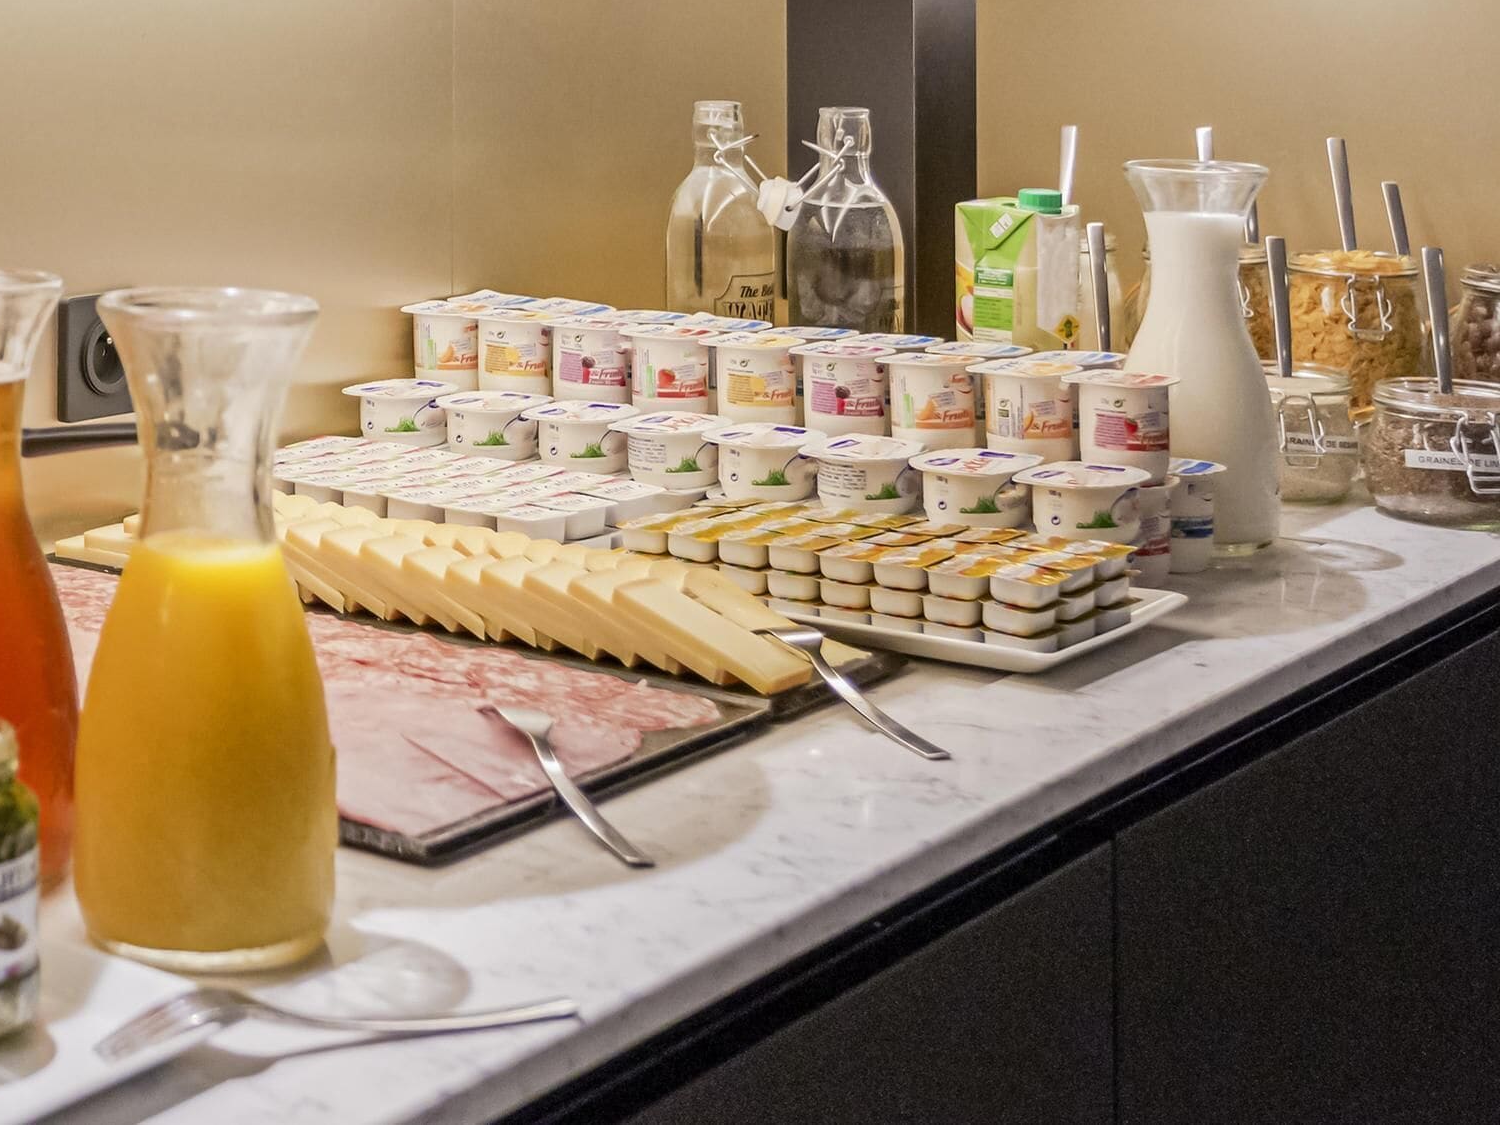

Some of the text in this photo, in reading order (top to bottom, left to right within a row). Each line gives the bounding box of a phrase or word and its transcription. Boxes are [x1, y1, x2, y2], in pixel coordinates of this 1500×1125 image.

[740, 285, 759, 299] The
[723, 301, 774, 321] WAT
[1483, 459, 1500, 468] LIN
